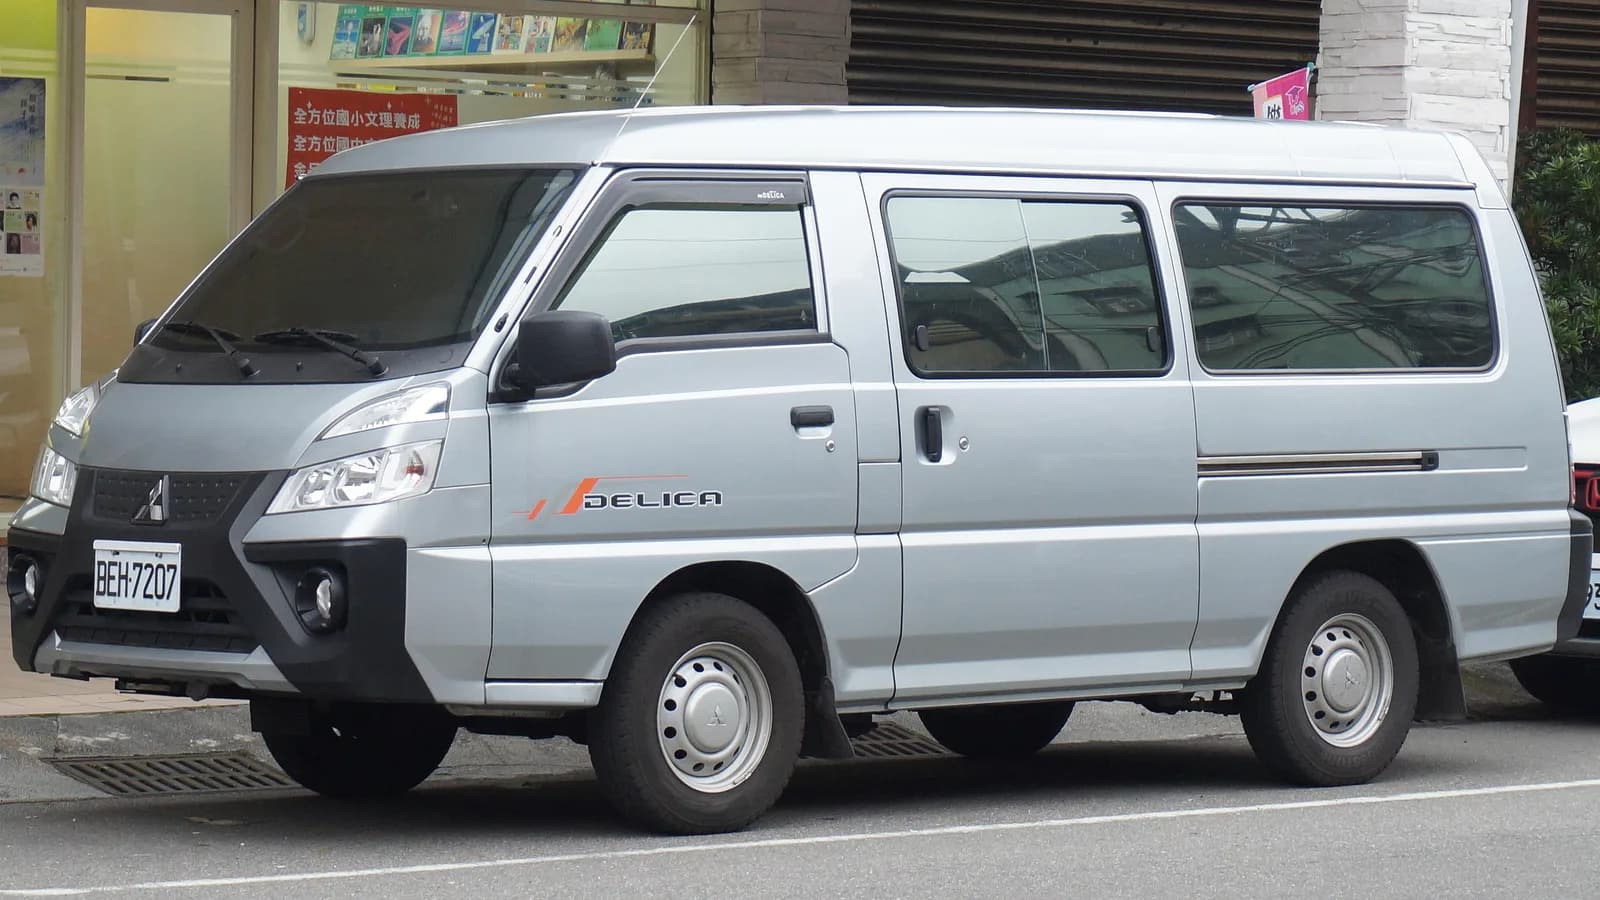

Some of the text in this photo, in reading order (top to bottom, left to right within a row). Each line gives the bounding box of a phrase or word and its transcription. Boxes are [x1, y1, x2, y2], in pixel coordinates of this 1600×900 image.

[294, 107, 420, 129] 全方位國小文理養成
[583, 490, 723, 511] DELICA
